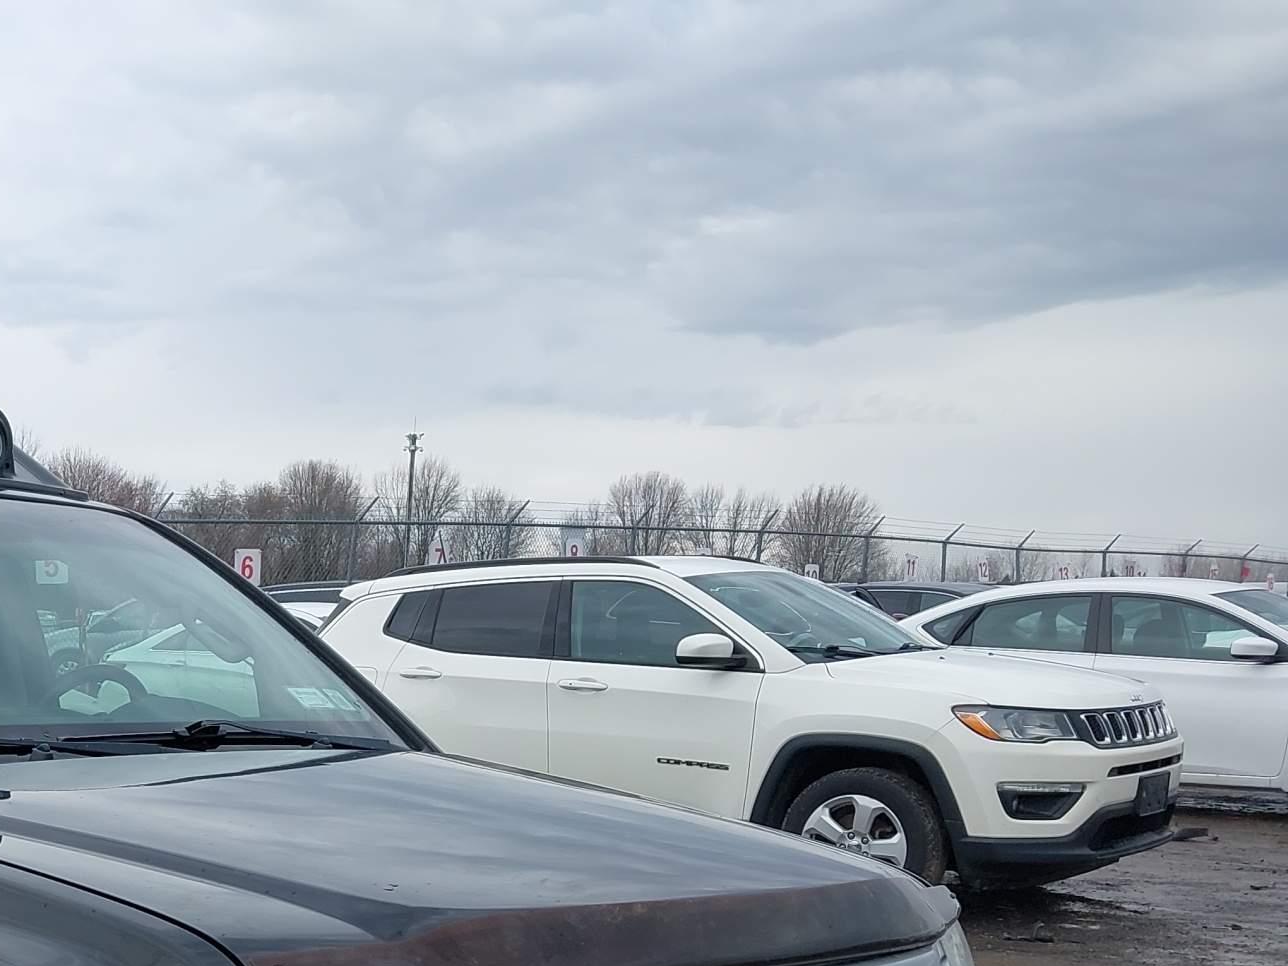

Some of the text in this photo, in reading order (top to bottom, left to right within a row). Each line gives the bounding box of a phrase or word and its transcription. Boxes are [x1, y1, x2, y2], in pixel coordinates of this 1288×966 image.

[241, 555, 253, 579] 6
[907, 560, 915, 576] 11
[979, 562, 988, 577] 12
[656, 757, 730, 771] COMPASS
